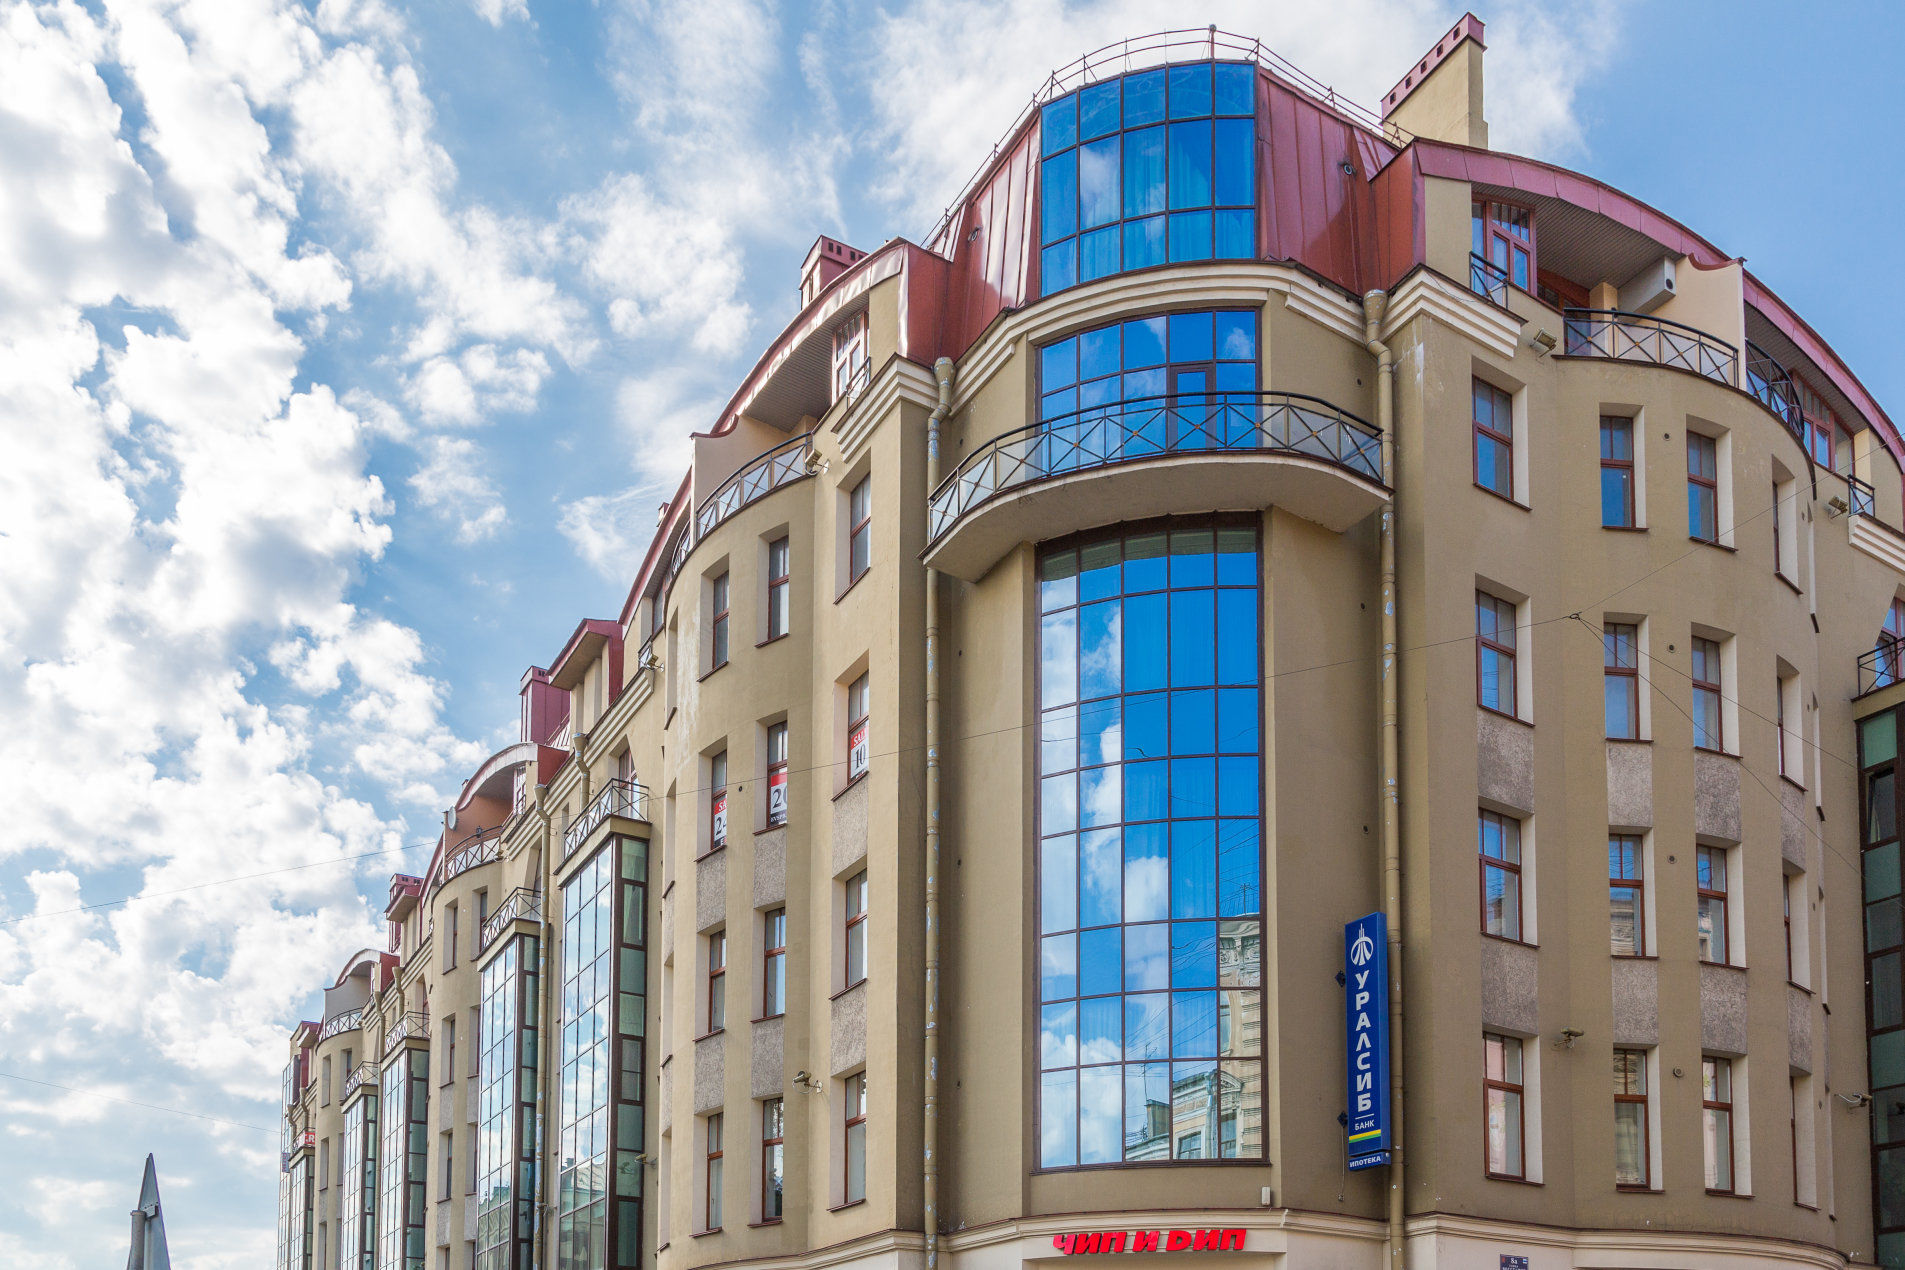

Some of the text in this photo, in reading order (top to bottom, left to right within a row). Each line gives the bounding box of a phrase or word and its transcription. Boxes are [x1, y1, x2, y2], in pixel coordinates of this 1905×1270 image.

[1355, 970, 1372, 1112] УРАЛСИБ
[1355, 1119, 1375, 1130] БАНК
[1349, 1156, 1381, 1168] ИПОТЕКА
[1053, 1231, 1127, 1255] ЧИП
[1132, 1231, 1160, 1252] И
